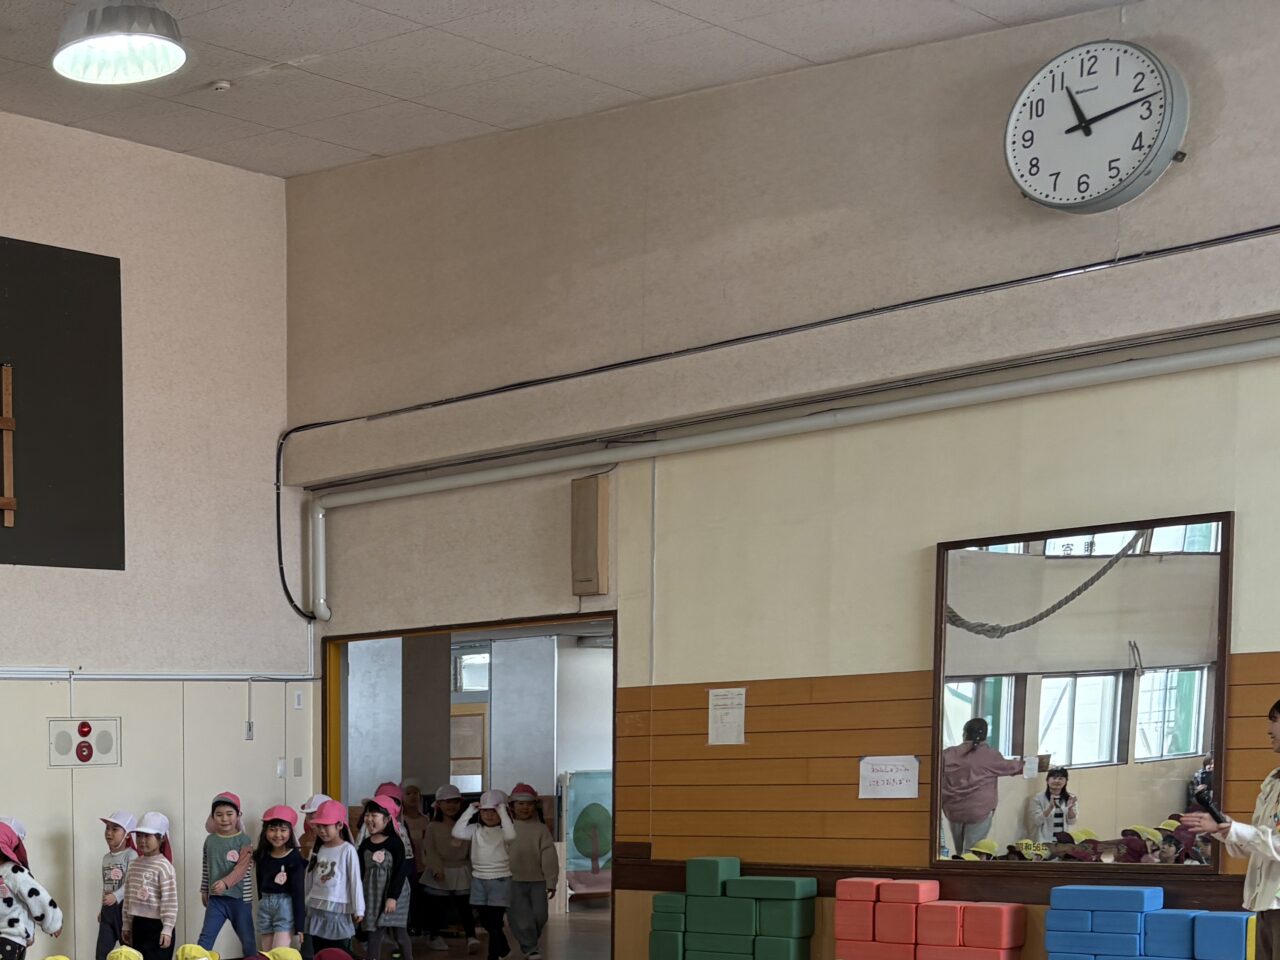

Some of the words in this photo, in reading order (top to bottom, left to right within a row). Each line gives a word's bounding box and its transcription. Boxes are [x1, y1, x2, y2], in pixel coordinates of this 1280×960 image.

[1080, 55, 1098, 78] 12
[1115, 56, 1120, 76] 1
[1051, 72, 1064, 93] 11
[1132, 72, 1145, 93] 2
[1029, 98, 1044, 120] 10
[1139, 100, 1152, 120] 3
[1021, 130, 1034, 149] 9
[1131, 131, 1144, 151] 4
[1029, 157, 1039, 176] 8
[1108, 158, 1120, 179] 5
[1049, 171, 1061, 192] 7
[1077, 174, 1090, 193] 6
